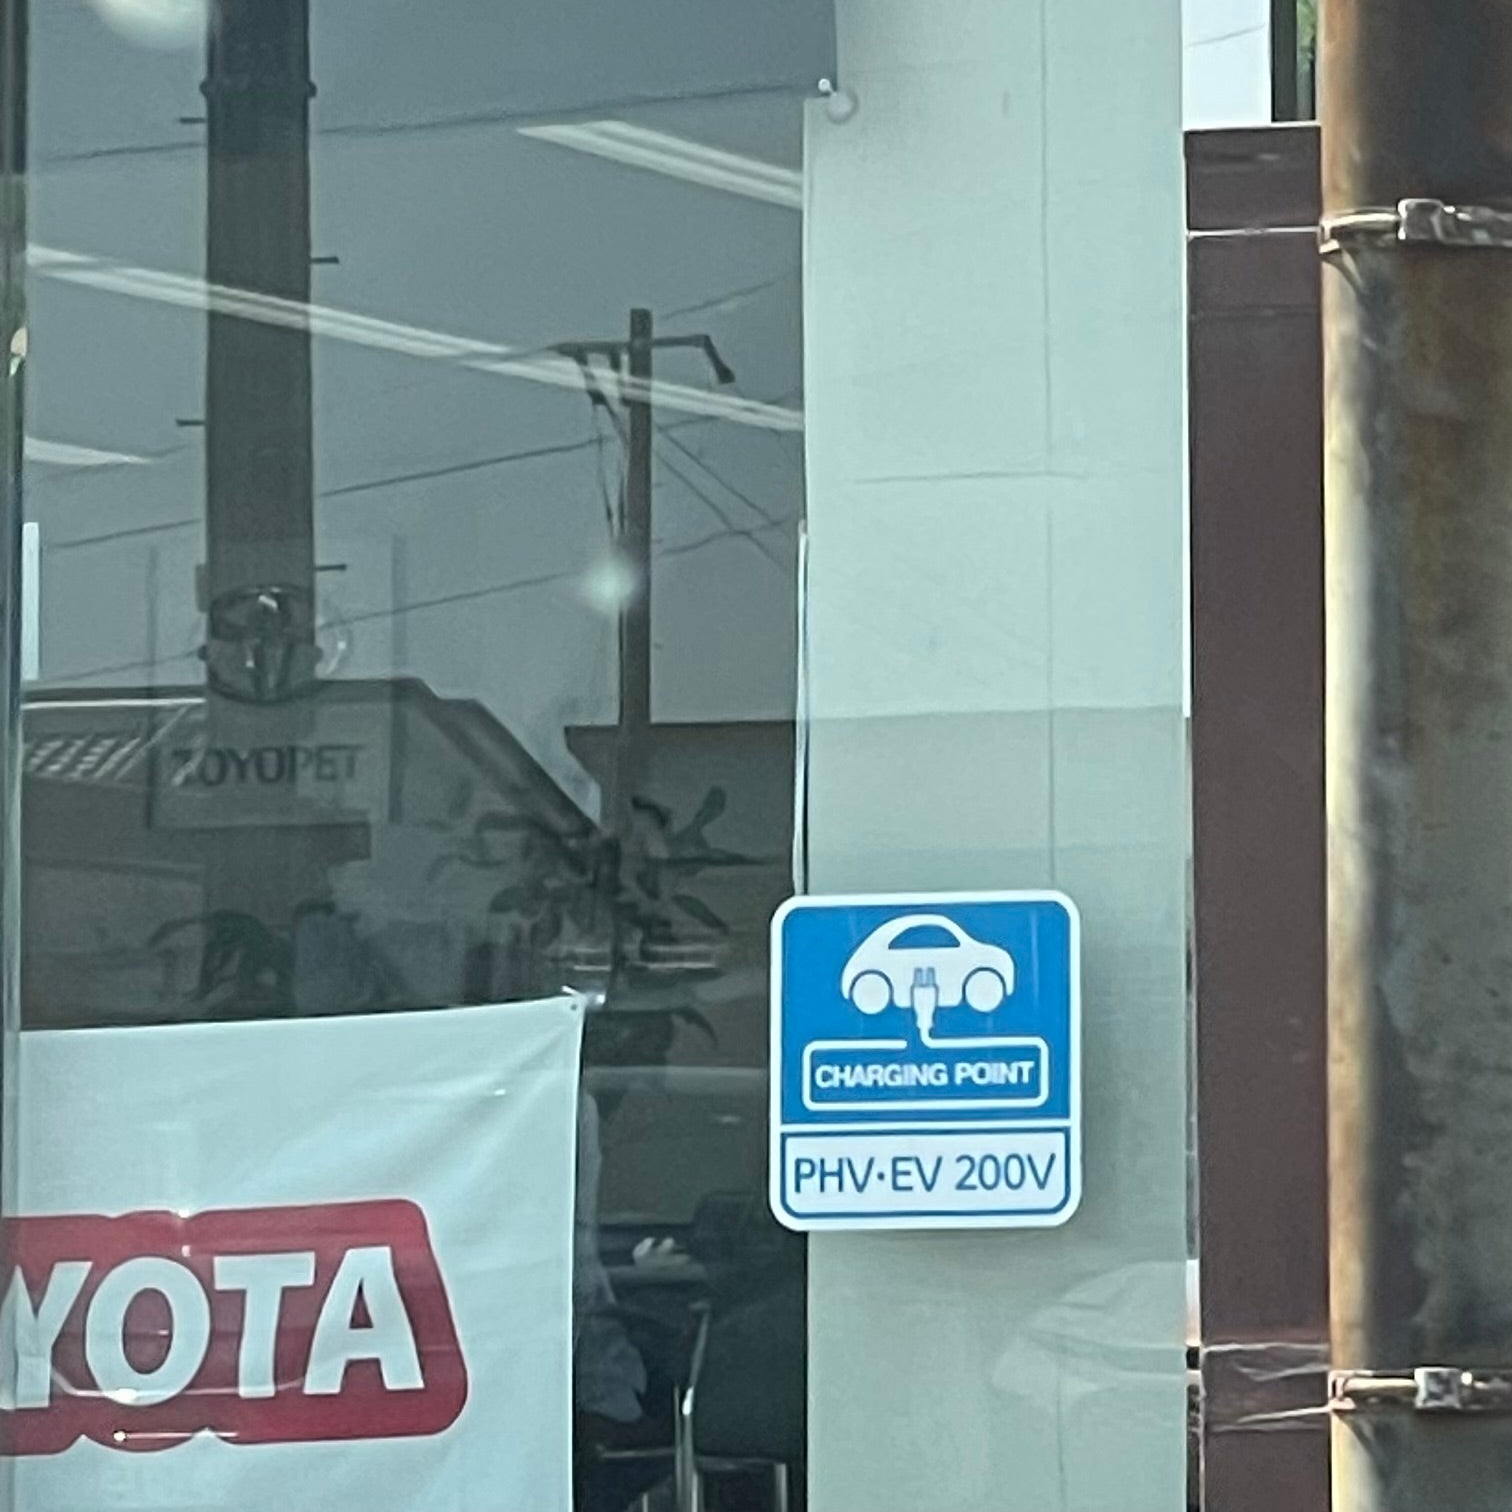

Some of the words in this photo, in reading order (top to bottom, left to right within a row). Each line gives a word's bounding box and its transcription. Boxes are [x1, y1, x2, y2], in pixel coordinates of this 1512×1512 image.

[814, 1061, 949, 1089] CHARGING
[954, 1060, 1035, 1086] POINT
[954, 1152, 1057, 1191] 200V
